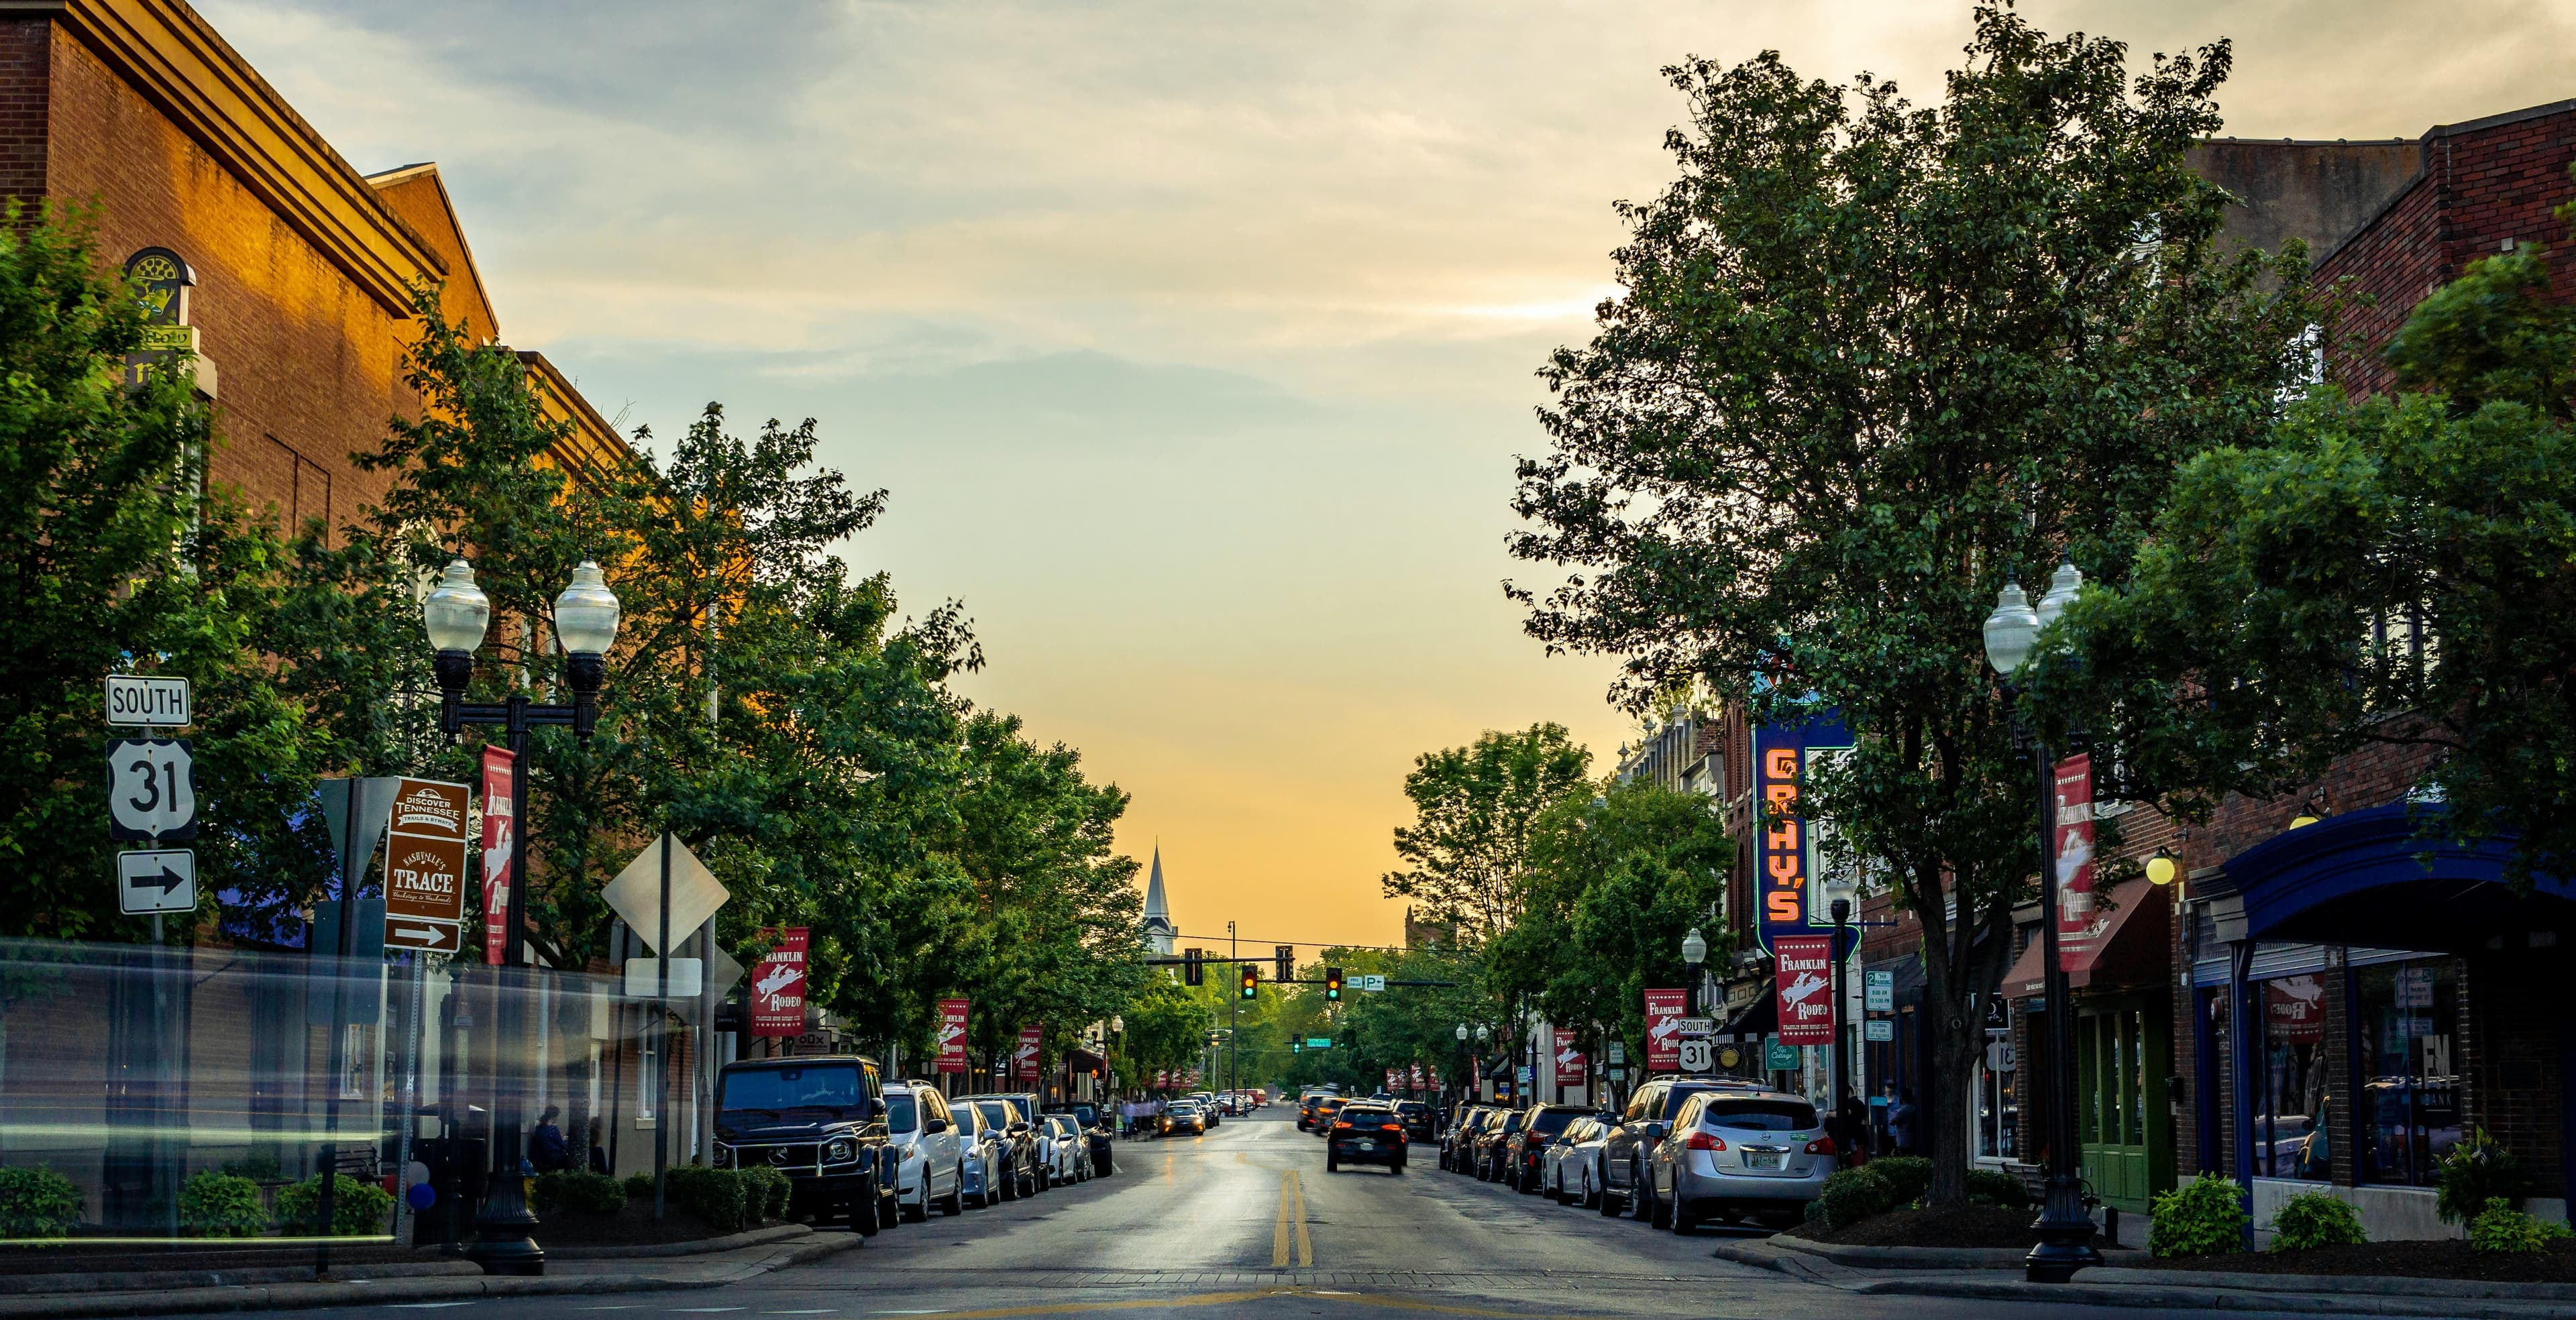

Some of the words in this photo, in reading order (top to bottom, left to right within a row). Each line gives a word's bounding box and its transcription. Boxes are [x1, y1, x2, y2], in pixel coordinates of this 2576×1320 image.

[113, 687, 182, 714] SOUTH
[129, 760, 177, 813] 31
[407, 797, 451, 808] DISCOVER
[396, 802, 460, 820] TENNESSEE
[431, 818, 452, 826] BYWAYS
[1766, 749, 1805, 922] GRAY'S
[394, 869, 453, 893] TRACE
[765, 952, 803, 963] RANKLIN
[1780, 954, 1826, 972] FRANKLIN
[1367, 977, 1376, 988] P
[1868, 975, 1874, 984] 2
[771, 994, 801, 1011] RODEO
[1649, 1002, 1683, 1015] FRANKLIN
[1798, 1002, 1828, 1020] RODEO
[1680, 1021, 1710, 1032] SOUTH
[943, 1043, 963, 1055] RODEO
[1685, 1046, 1705, 1064] 31
[1776, 1046, 1786, 1054] Tin
[1771, 1051, 1792, 1060] Cottage
[1566, 1062, 1583, 1072] RODEO
